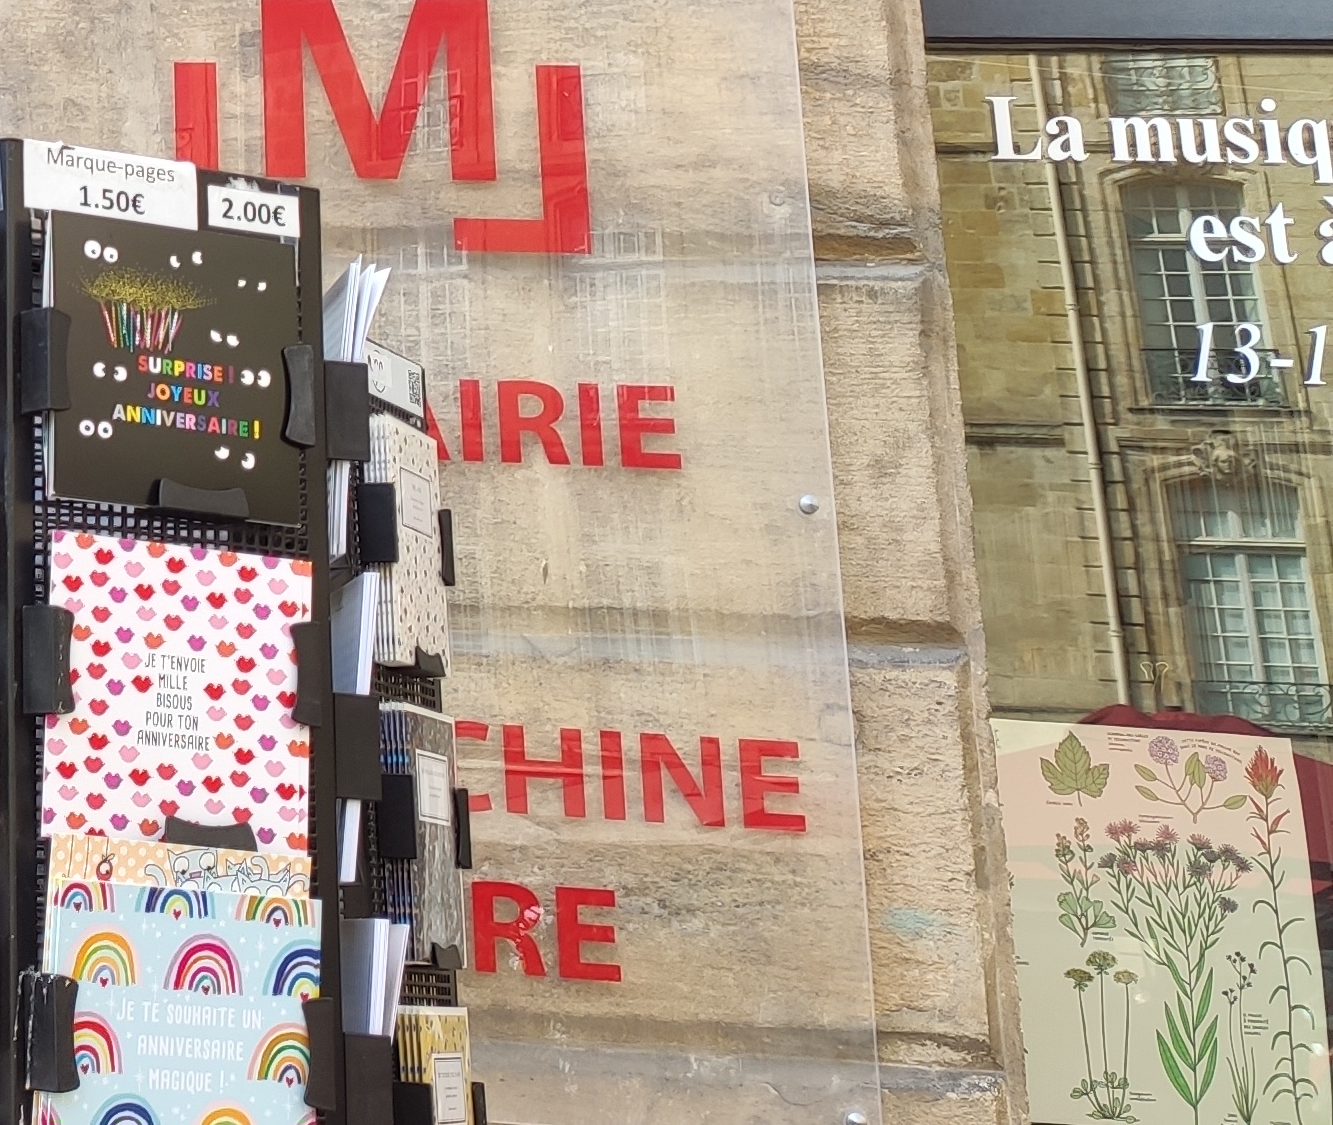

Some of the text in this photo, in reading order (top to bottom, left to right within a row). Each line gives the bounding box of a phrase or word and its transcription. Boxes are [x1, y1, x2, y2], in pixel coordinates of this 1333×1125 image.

[984, 95, 1090, 163] La
[46, 147, 175, 183] Marque-pages
[78, 185, 146, 216] 1.50€
[221, 196, 286, 227] 2.00€
[1189, 201, 1299, 264] est
[137, 355, 223, 383] SURPRISE
[147, 383, 220, 408] JOYEUX
[112, 404, 250, 437] ANNIVERSAIRE
[144, 653, 206, 673] JE T'ENVOIE
[158, 673, 188, 691] MILLE
[156, 692, 193, 711] BISOUS
[145, 711, 199, 731] POUR TON
[137, 730, 211, 751] ANNIVERSAIRE
[116, 997, 262, 1030] JE TE SOUHAITE UN
[137, 1035, 244, 1061] ANNIVERSAIRE
[148, 1068, 213, 1095] MAGIQUE
